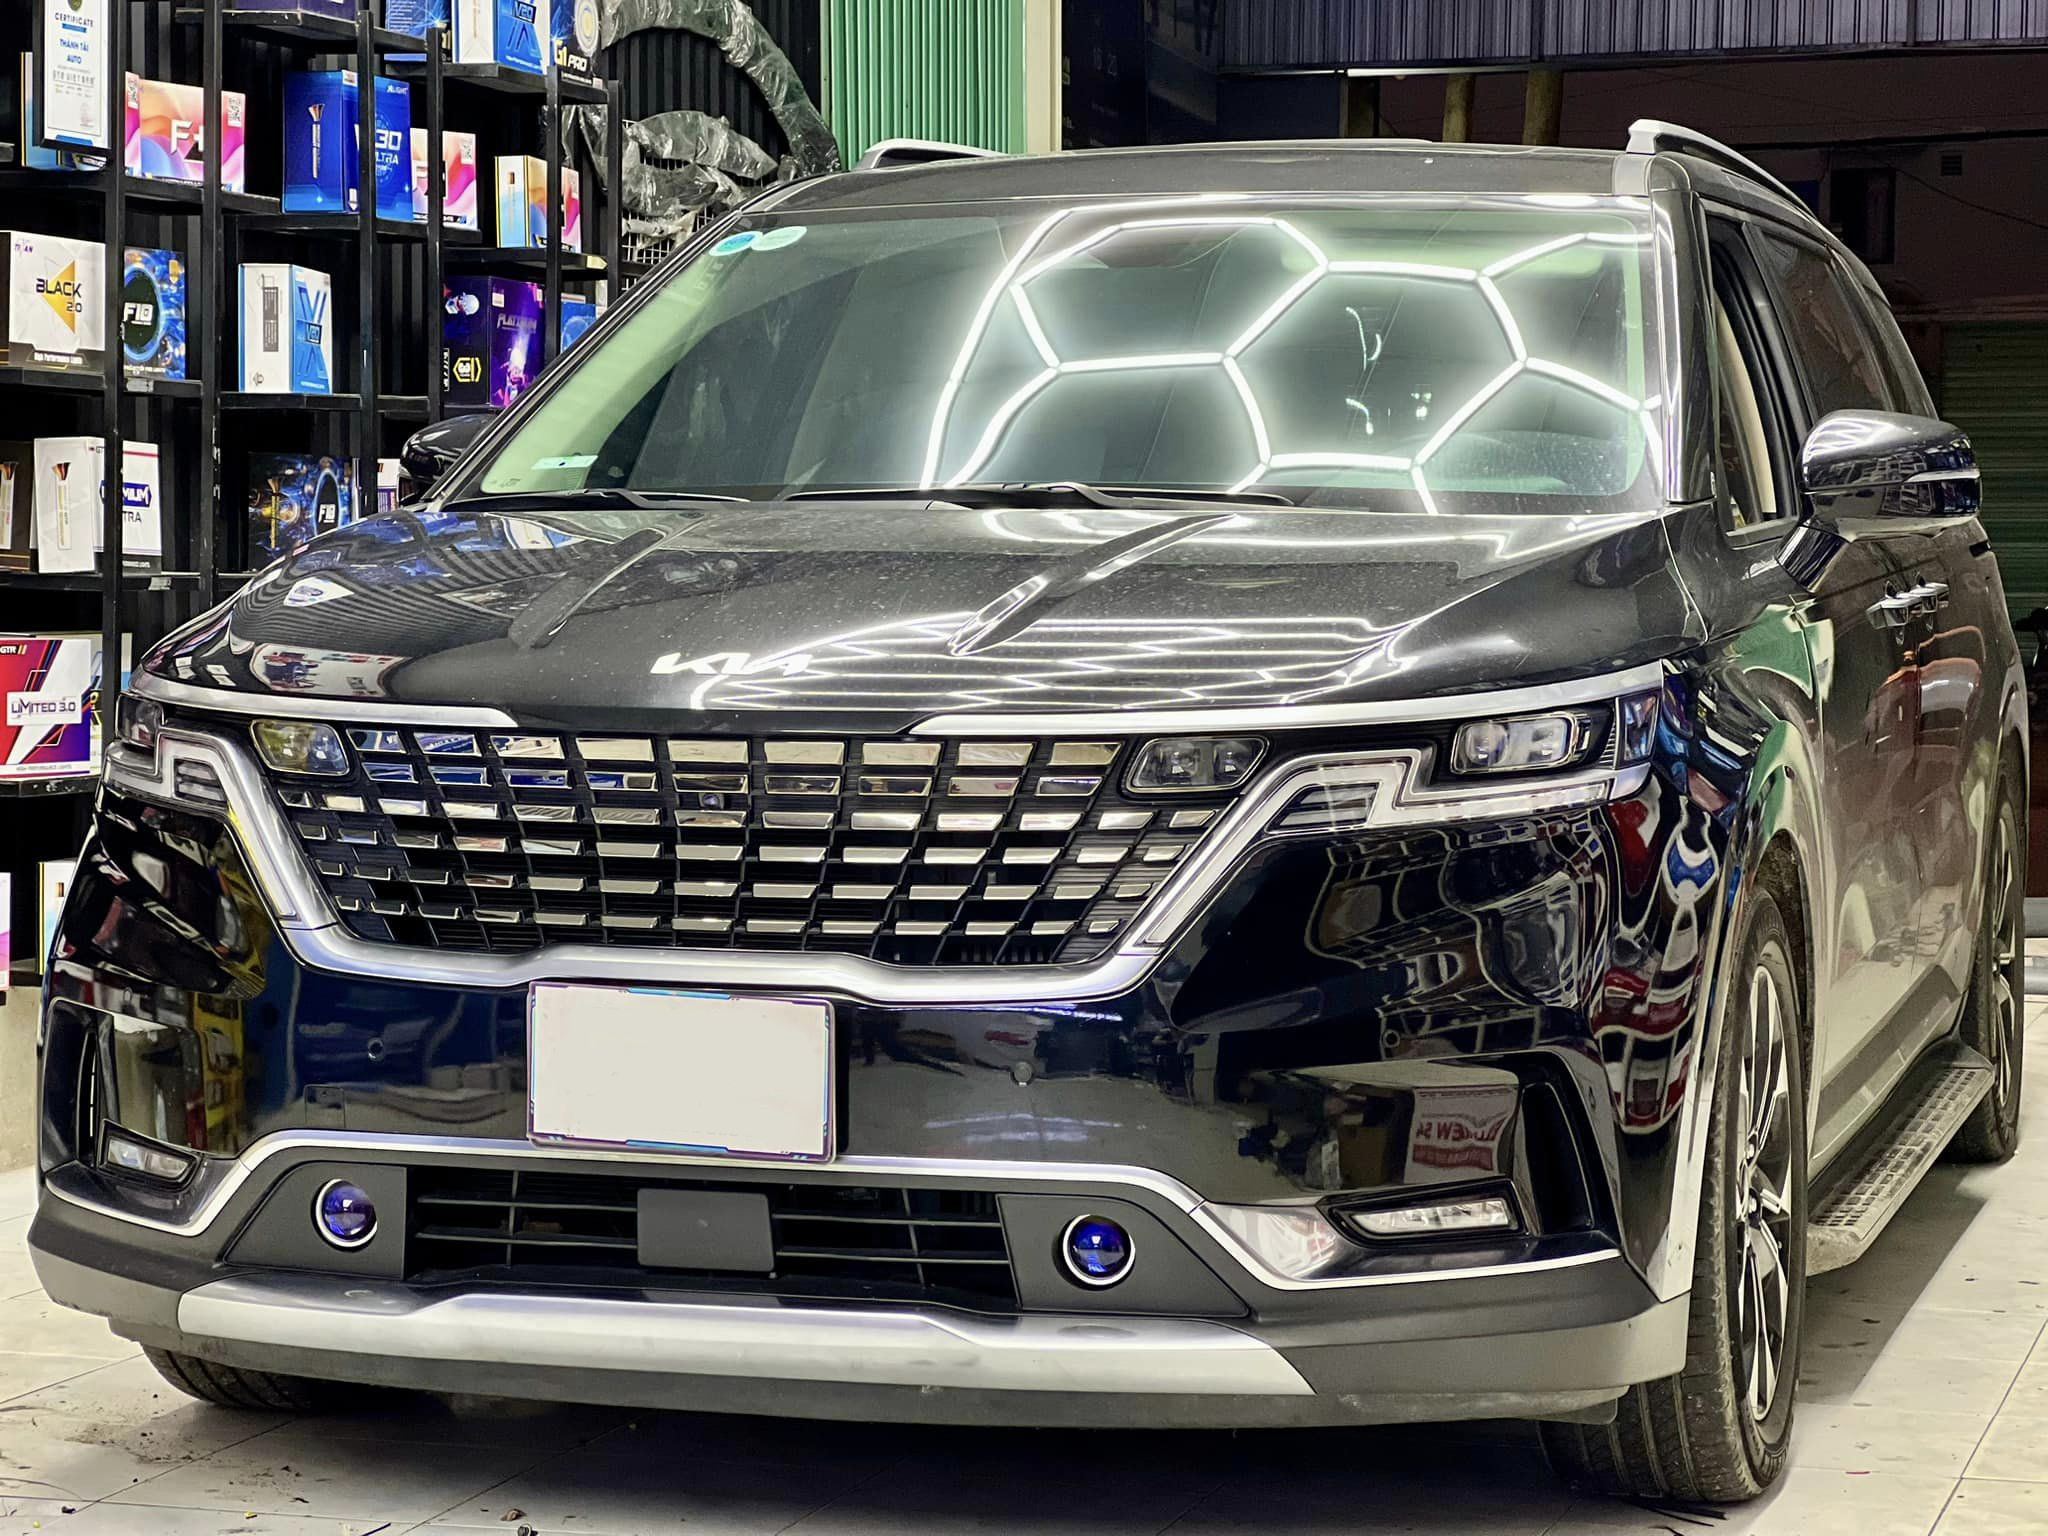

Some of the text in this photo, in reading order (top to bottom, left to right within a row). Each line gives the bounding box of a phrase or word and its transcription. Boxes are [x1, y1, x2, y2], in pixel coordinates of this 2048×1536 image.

[55, 12, 93, 27] CERTIFICATE
[568, 54, 587, 72] PRO
[36, 278, 82, 298] BLACK
[124, 302, 153, 321] F10
[11, 698, 76, 715] LIMITED 3.0
